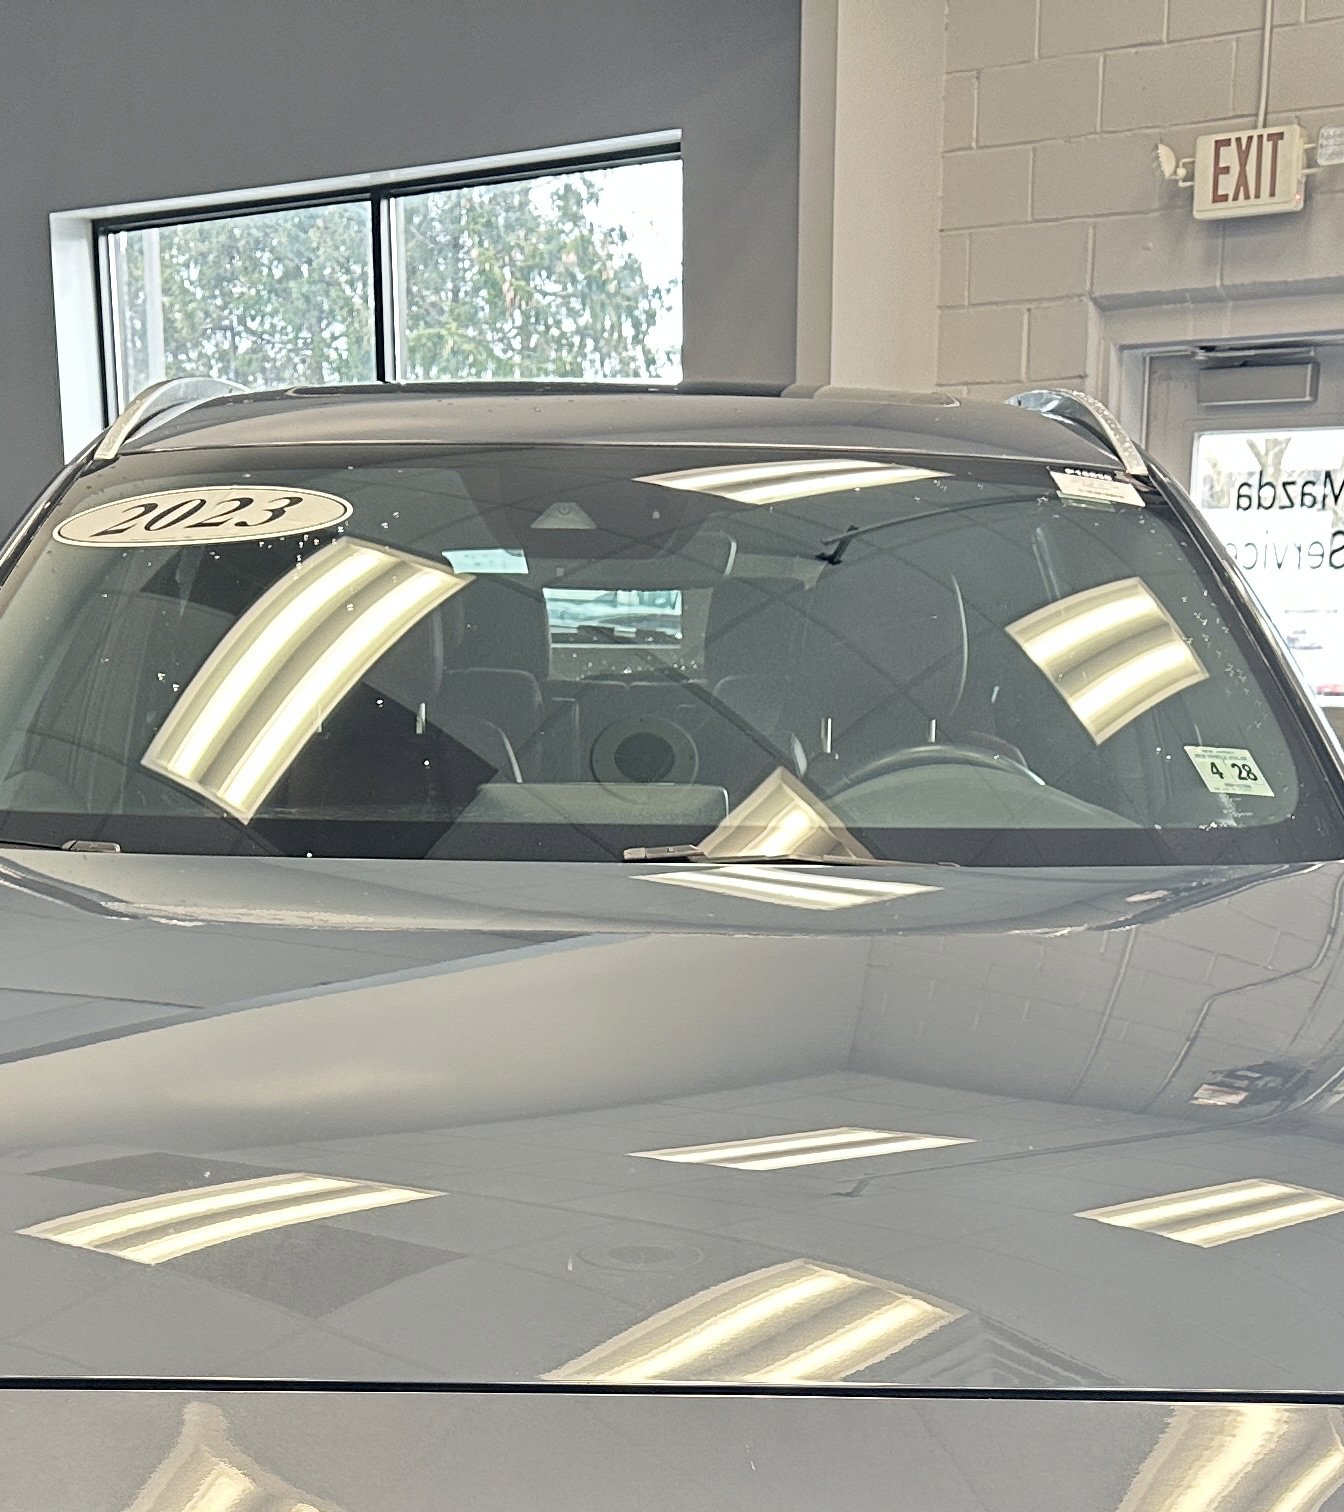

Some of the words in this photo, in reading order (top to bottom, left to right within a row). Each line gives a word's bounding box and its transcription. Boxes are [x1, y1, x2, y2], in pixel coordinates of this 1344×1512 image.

[1212, 131, 1284, 204] EXIT
[89, 497, 303, 538] 2023
[1210, 761, 1225, 780] 4
[1231, 763, 1258, 781] 28
